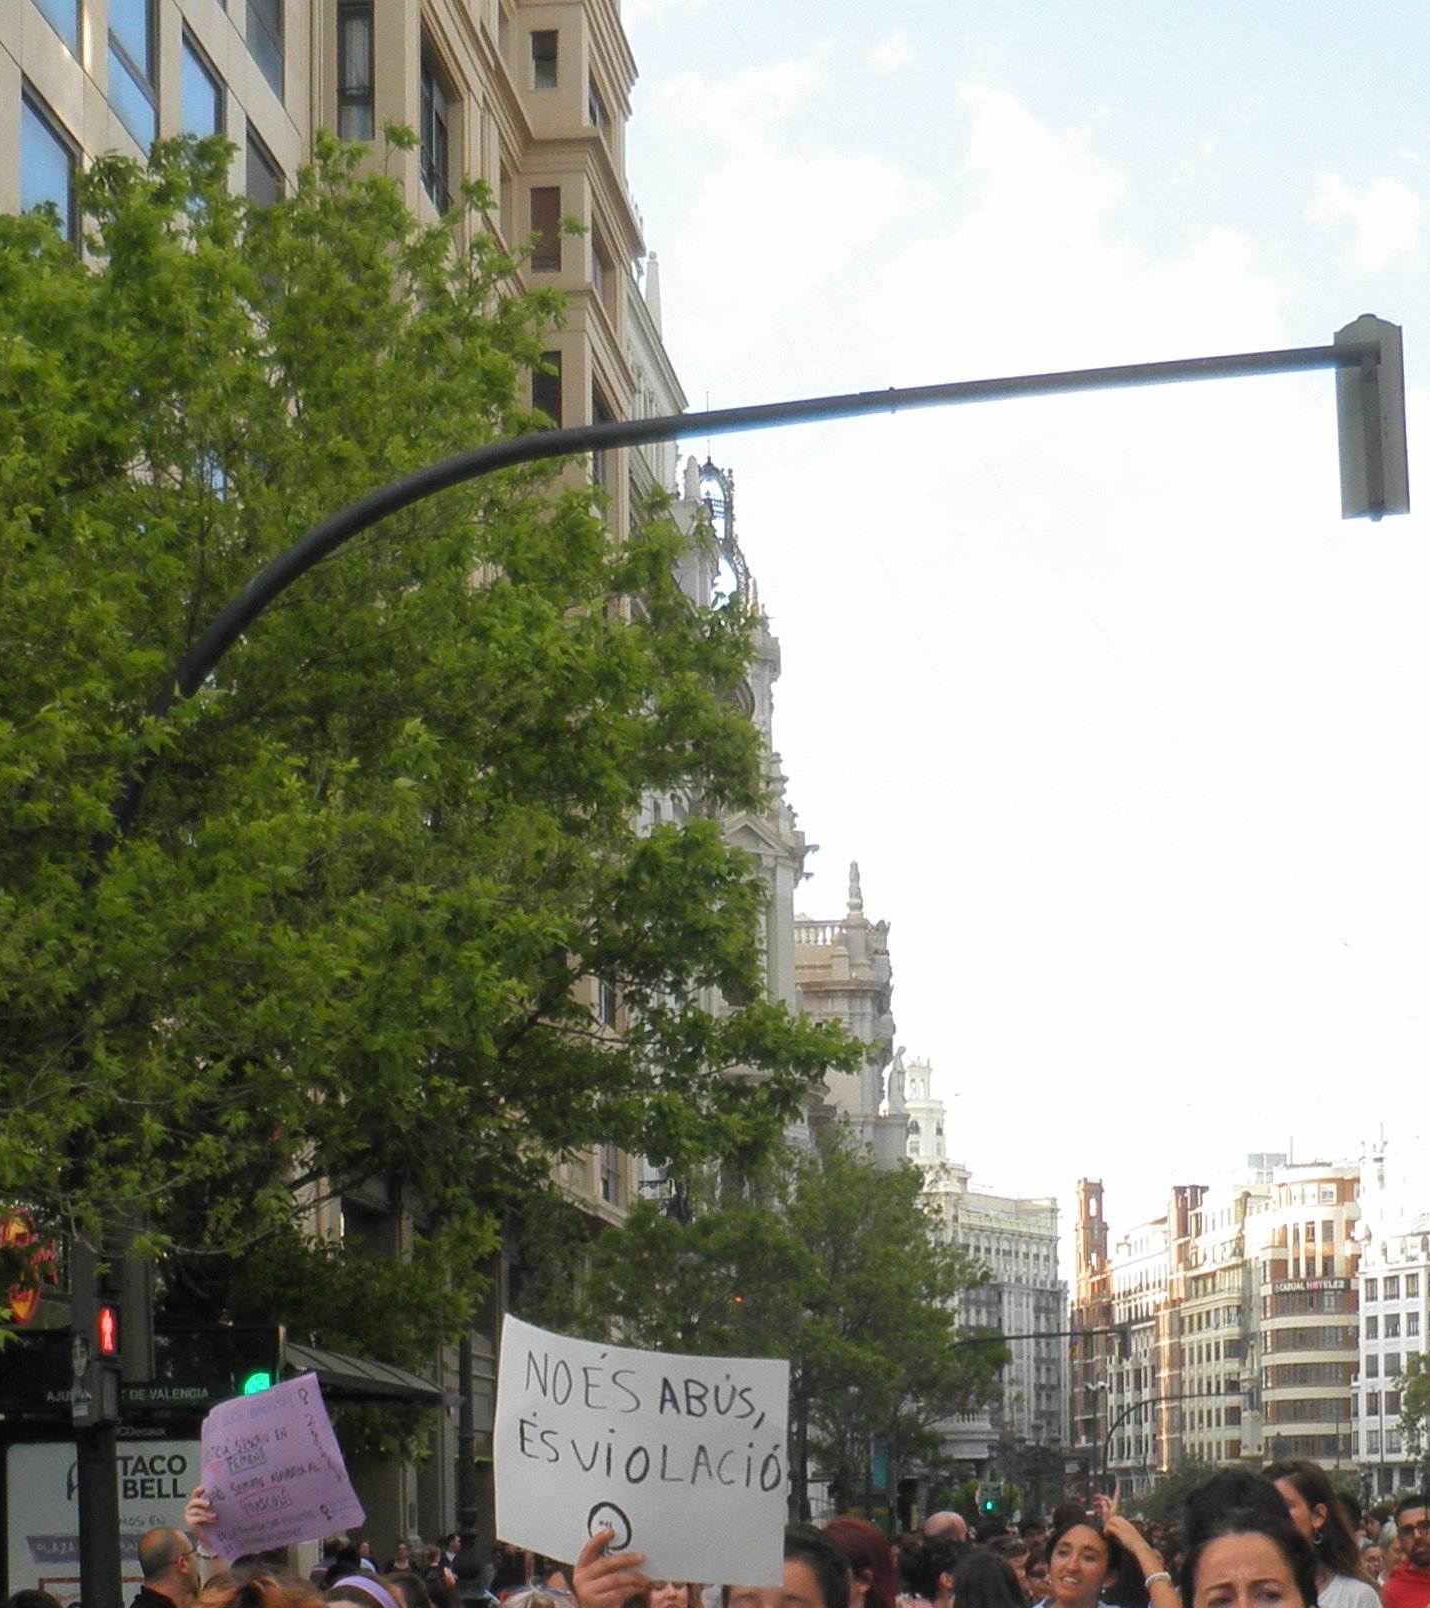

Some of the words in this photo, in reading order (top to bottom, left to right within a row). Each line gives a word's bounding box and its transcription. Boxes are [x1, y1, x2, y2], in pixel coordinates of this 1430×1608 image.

[129, 1389, 146, 1401] DE
[149, 1387, 209, 1400] VALENCIA
[659, 1373, 766, 1430] ABÚS,
[519, 1411, 560, 1463] ÉS
[119, 1454, 188, 1477] TACO
[122, 1478, 187, 1500] BELL
